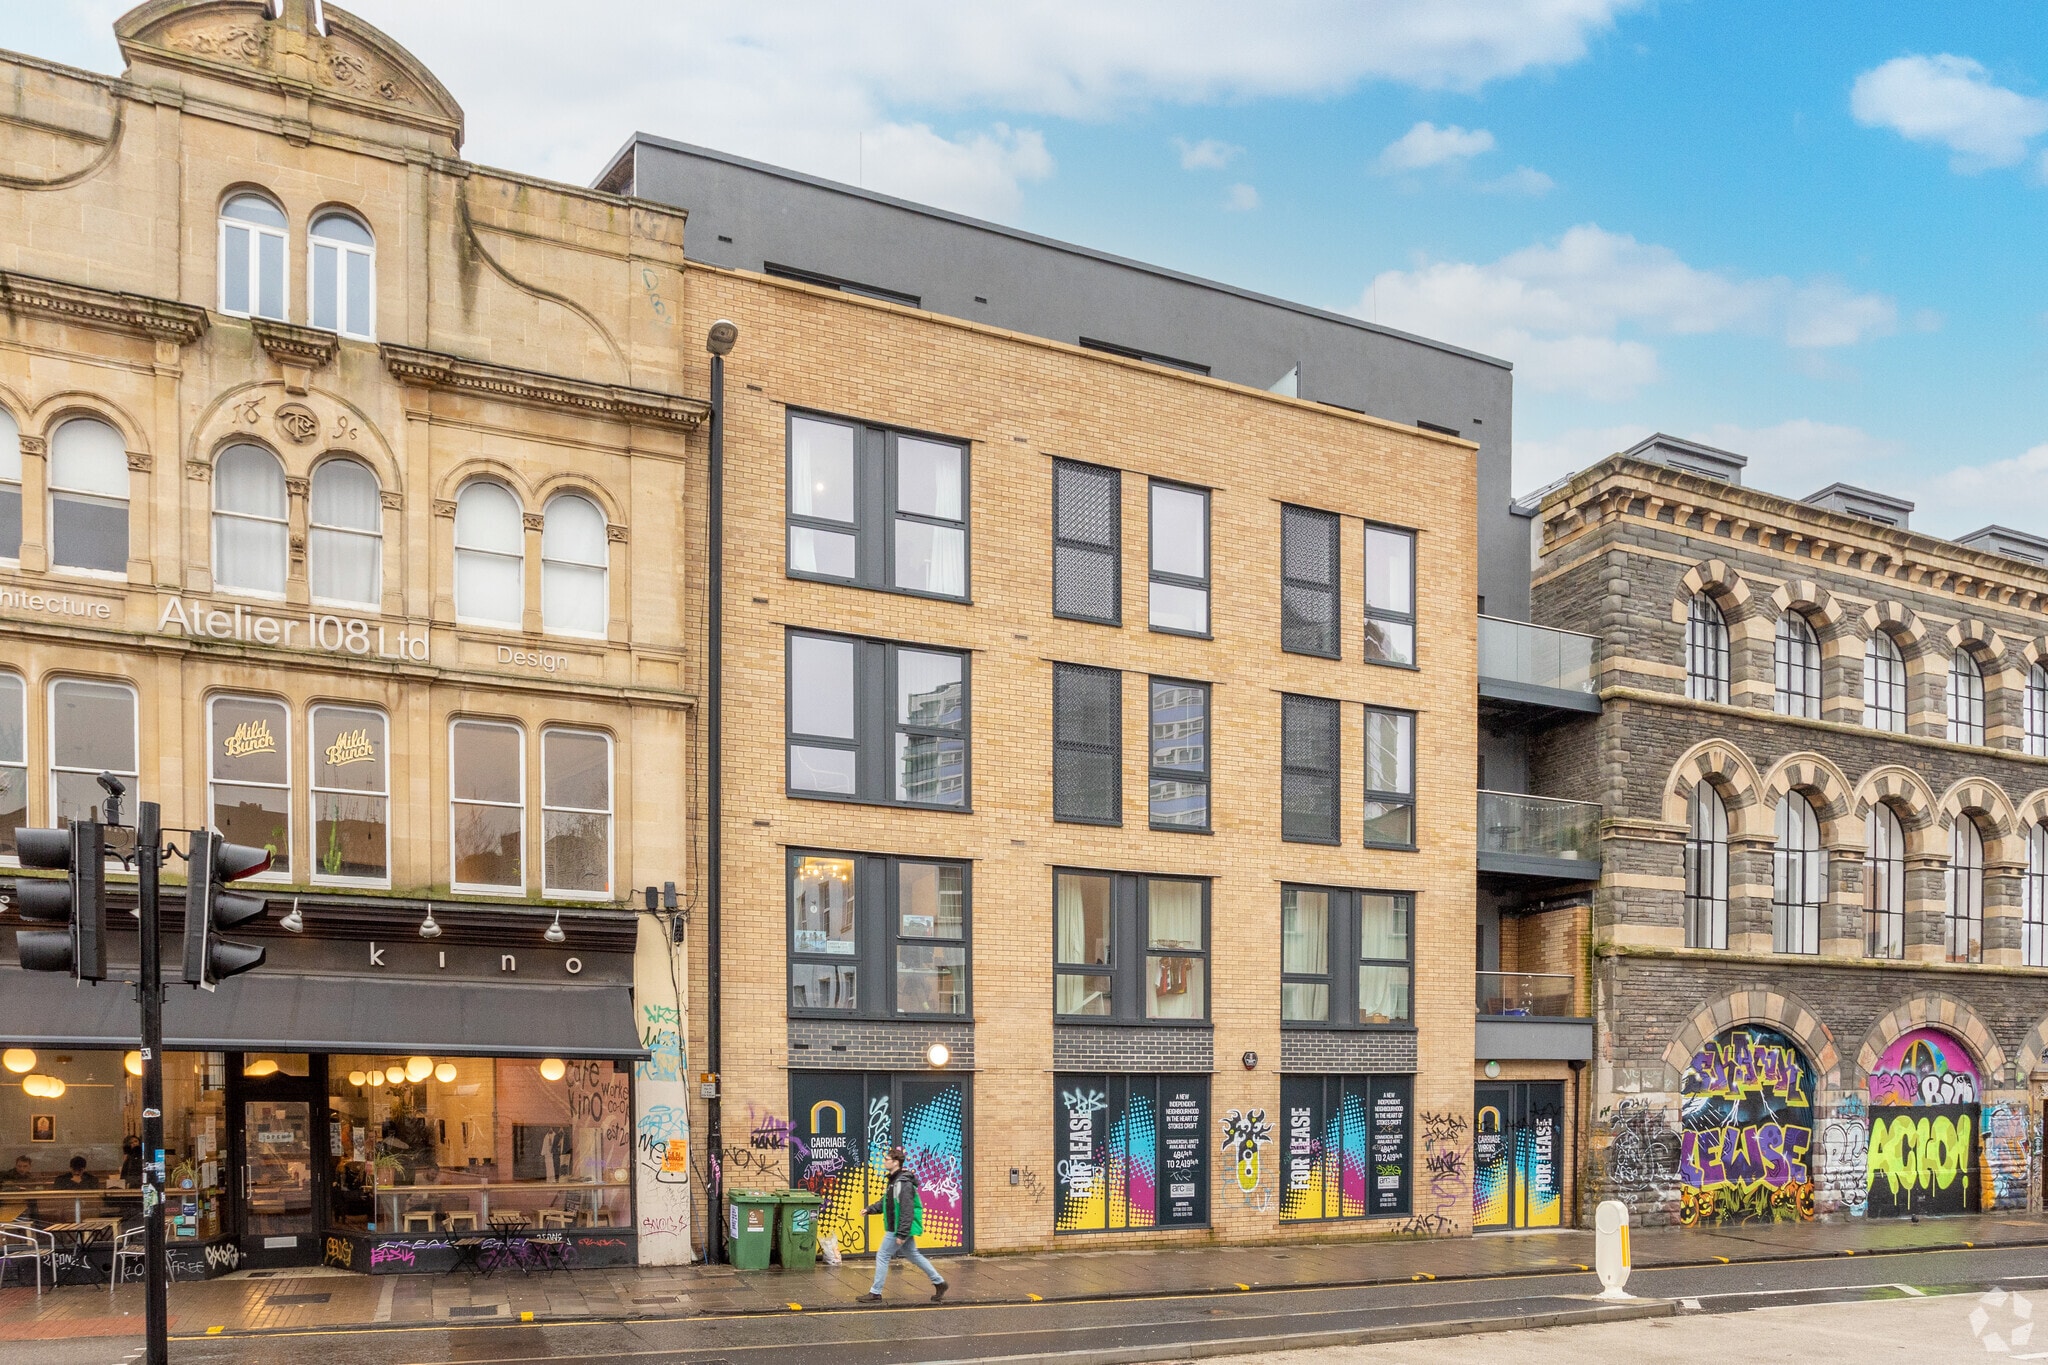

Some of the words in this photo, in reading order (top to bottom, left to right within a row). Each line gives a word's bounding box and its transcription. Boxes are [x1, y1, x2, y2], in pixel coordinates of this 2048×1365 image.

[0, 587, 111, 619] hitecture
[157, 596, 300, 646] Atelier
[378, 626, 429, 661] Ltd
[497, 645, 568, 673] Design
[224, 730, 275, 756] Bunch
[235, 719, 268, 741] Mild
[335, 728, 367, 750] Mild
[325, 738, 374, 765] Bunch
[811, 1137, 847, 1148] CARRIAGE
[1069, 1109, 1092, 1160] LEASE
[1290, 1107, 1311, 1155] LEASE
[1477, 1134, 1501, 1144] CARRIAGE
[1535, 1118, 1552, 1161] LEASE
[811, 1148, 839, 1159] WORKS
[1477, 1144, 1496, 1153] WORKS
[1069, 1164, 1092, 1198] FOR
[1290, 1158, 1311, 1190] FOR
[1535, 1163, 1552, 1192] FOR
